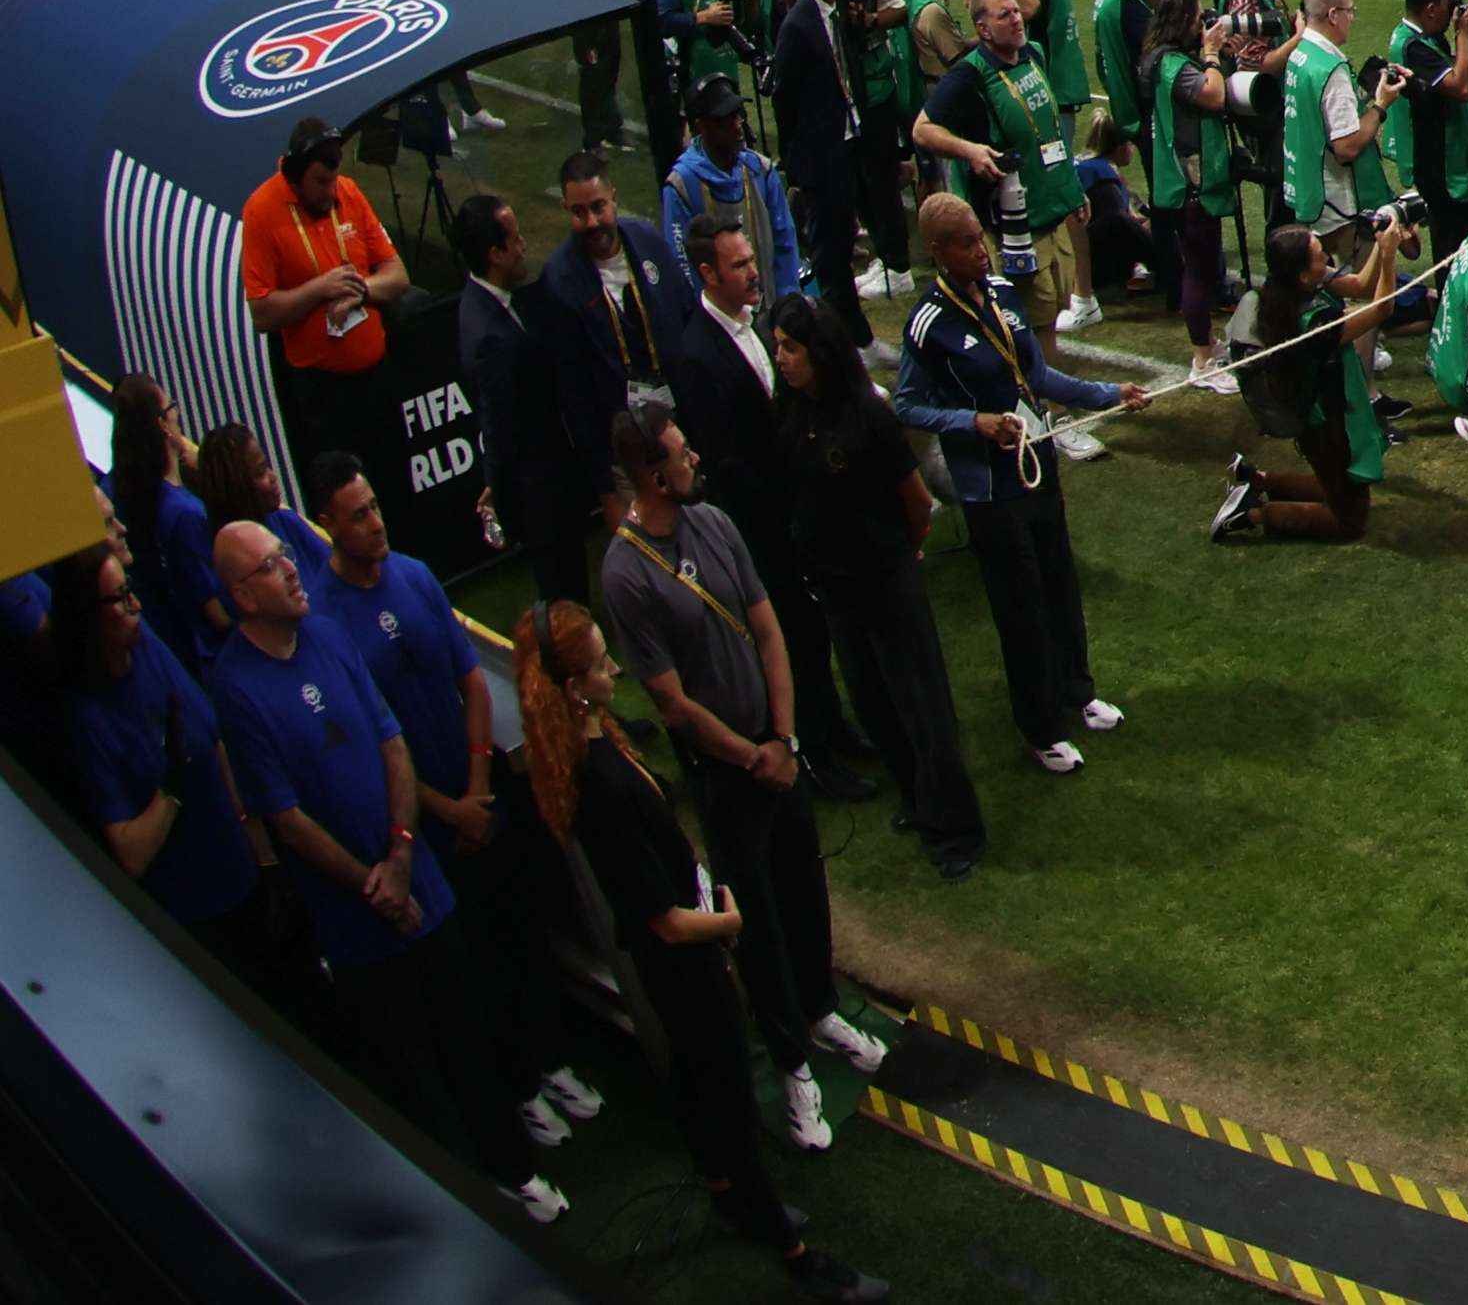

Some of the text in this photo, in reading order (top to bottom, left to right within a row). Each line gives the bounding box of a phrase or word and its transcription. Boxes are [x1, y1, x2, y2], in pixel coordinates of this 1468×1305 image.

[223, 46, 309, 99] SAINT GERMAIN
[1026, 90, 1050, 112] 629
[402, 380, 472, 439] FIFA
[410, 436, 475, 493] RLD
